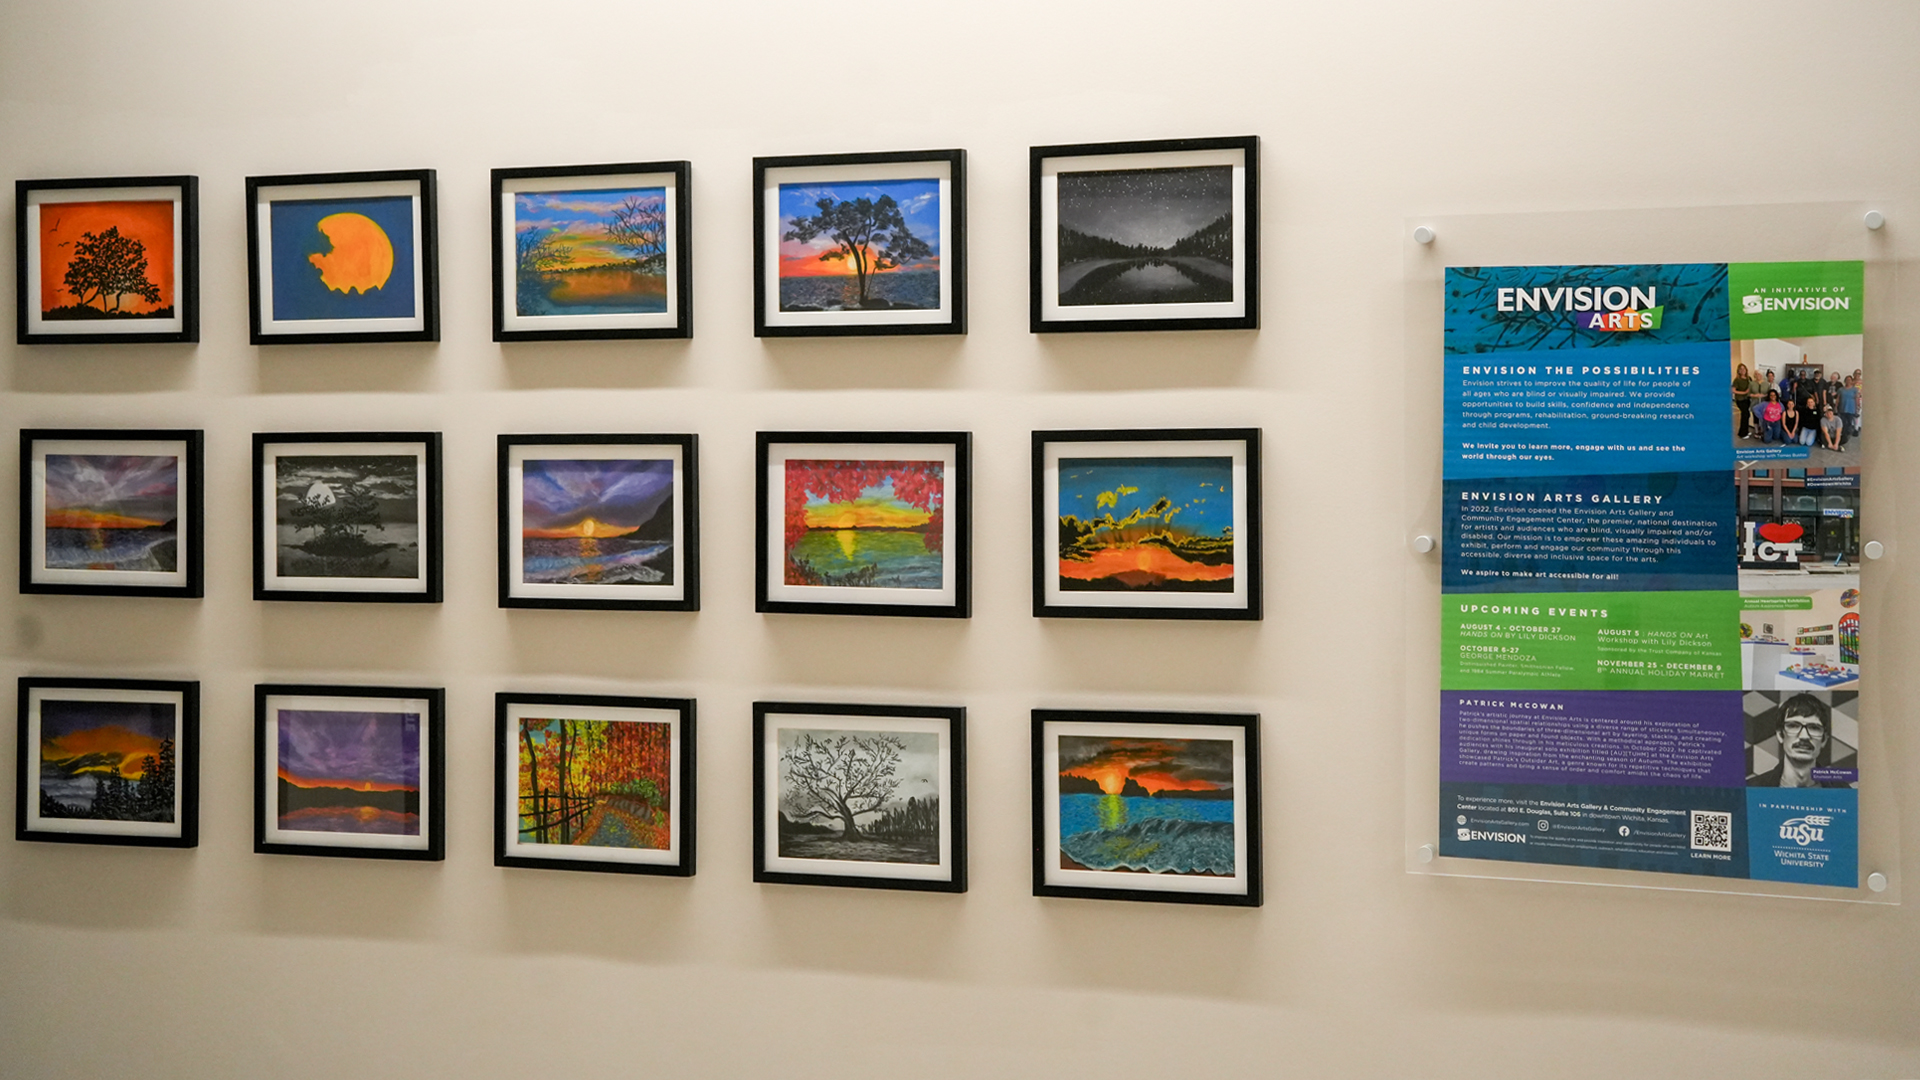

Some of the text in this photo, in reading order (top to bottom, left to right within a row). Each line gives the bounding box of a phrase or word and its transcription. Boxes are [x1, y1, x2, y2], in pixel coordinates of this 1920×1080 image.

[1497, 286, 1656, 312] ENVISION
[1764, 296, 1849, 310] ENVISION
[1588, 312, 1653, 329] ARTS
[1463, 366, 1700, 374] ENVISION THE POSSIBILITIES
[1462, 492, 1662, 503] ENVISION ARTS GALLERY
[1460, 605, 1608, 617] UPCOMING EVENTS
[1661, 637, 1676, 646] Lily
[1679, 638, 1712, 646] Dickson
[1770, 804, 1823, 812] PARTNERSHIP
[1471, 830, 1526, 844] ENVISION
